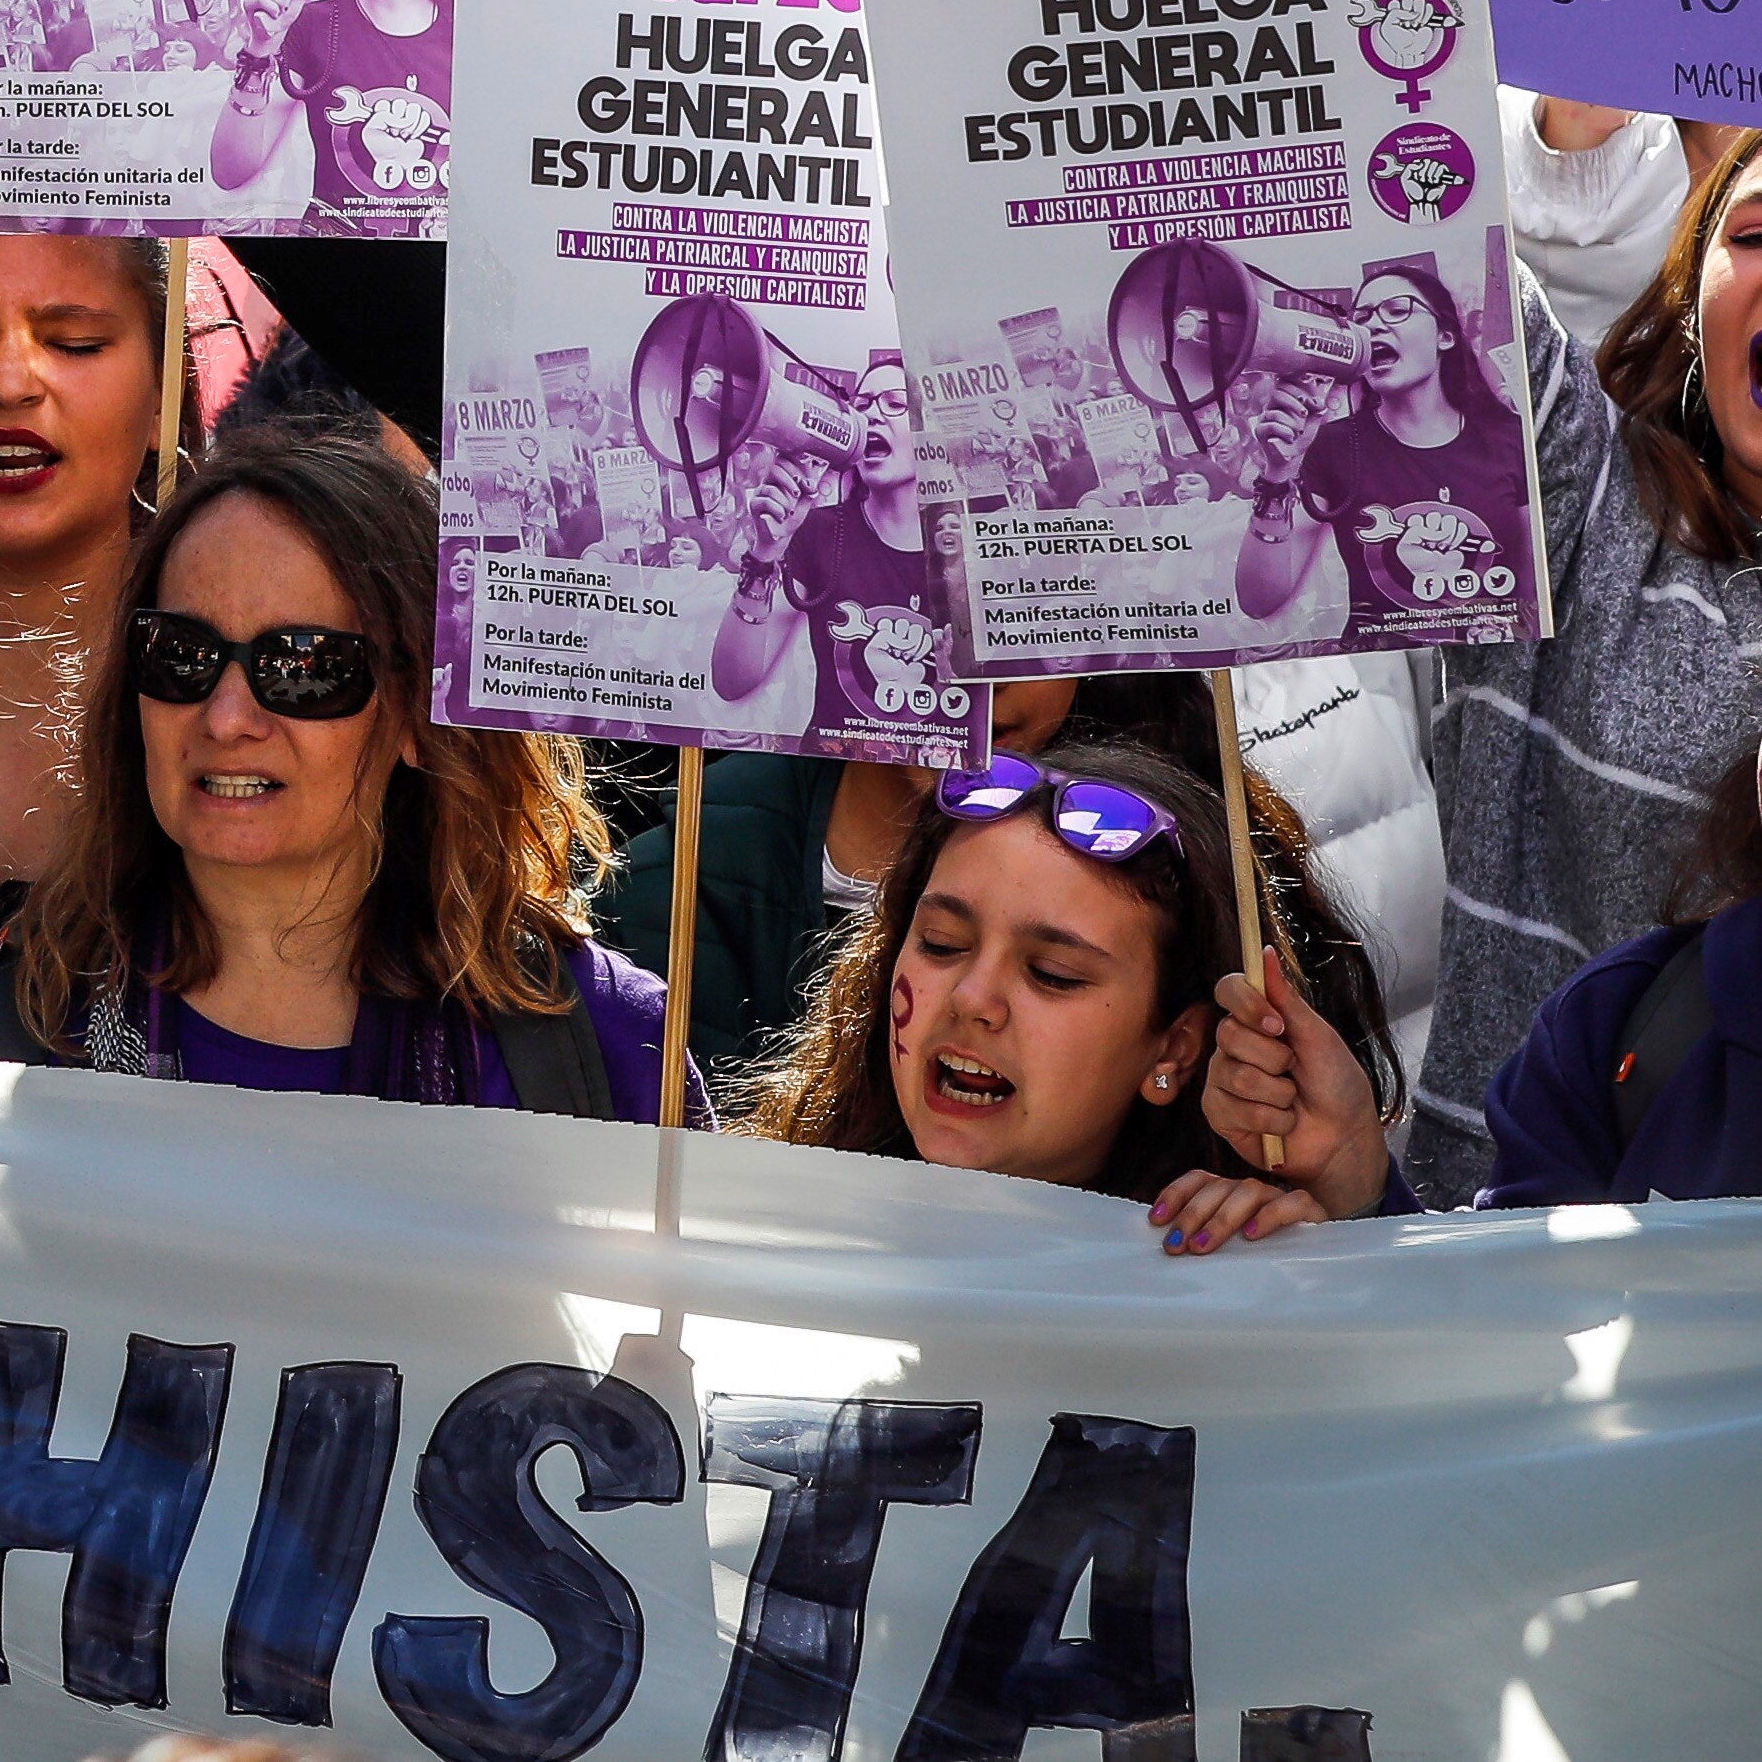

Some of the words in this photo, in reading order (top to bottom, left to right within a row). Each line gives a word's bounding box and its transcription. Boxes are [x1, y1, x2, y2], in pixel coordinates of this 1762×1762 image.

[615, 12, 870, 85] HUELGA
[1007, 21, 1336, 103] GENERAL
[577, 76, 872, 150] GENERAL
[964, 86, 1344, 163] ESTUDIANTIL
[531, 137, 871, 208] ESTUDIANTIL
[1064, 164, 1131, 191] CONTRA
[1135, 161, 1159, 185] LA
[1161, 154, 1253, 183] VIOLENCIA
[1254, 144, 1346, 173] MACHISTA
[921, 376, 937, 404] 8
[938, 363, 1010, 402] MARZO
[982, 581, 1014, 595] Por
[1019, 579, 1036, 593] la
[1040, 575, 1096, 592] tarde:
